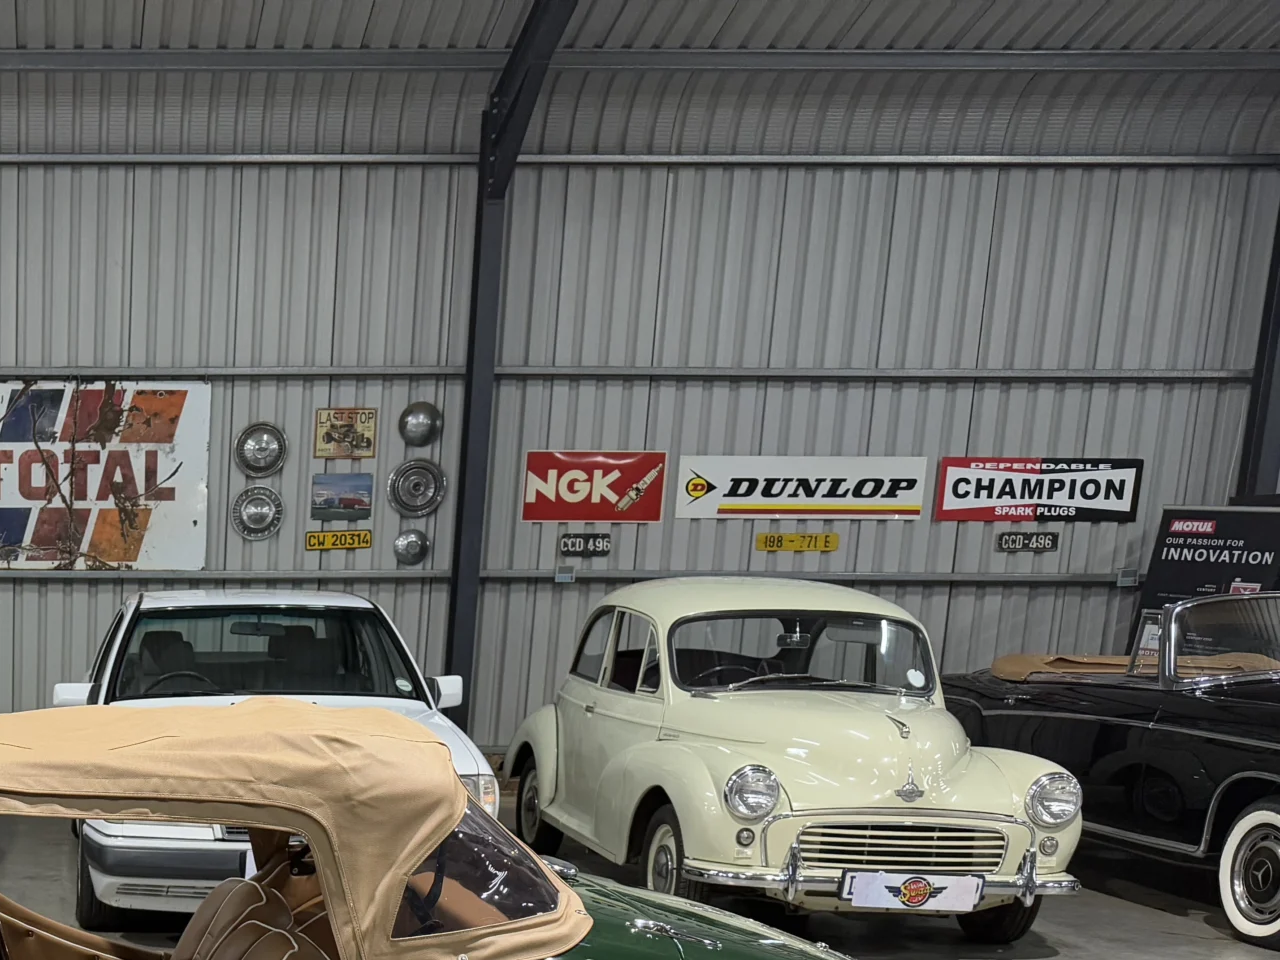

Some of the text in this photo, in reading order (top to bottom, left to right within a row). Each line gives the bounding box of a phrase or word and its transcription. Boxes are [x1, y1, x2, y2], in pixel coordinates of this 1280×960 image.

[318, 411, 375, 425] LAST STOP
[970, 462, 1113, 470] DEPENDABLE
[525, 469, 621, 504] NGK
[722, 478, 918, 499] DUNLOP
[951, 478, 1126, 501] CHAMPION
[994, 506, 1076, 516] SPARK PLUGS
[1171, 521, 1214, 532] MOTUL
[308, 533, 370, 547] CW 20314
[561, 538, 611, 551] CCD 496
[1001, 534, 1053, 549] CCD-496
[1186, 538, 1224, 546] PASSION
[1161, 547, 1275, 565] INNOVATION
